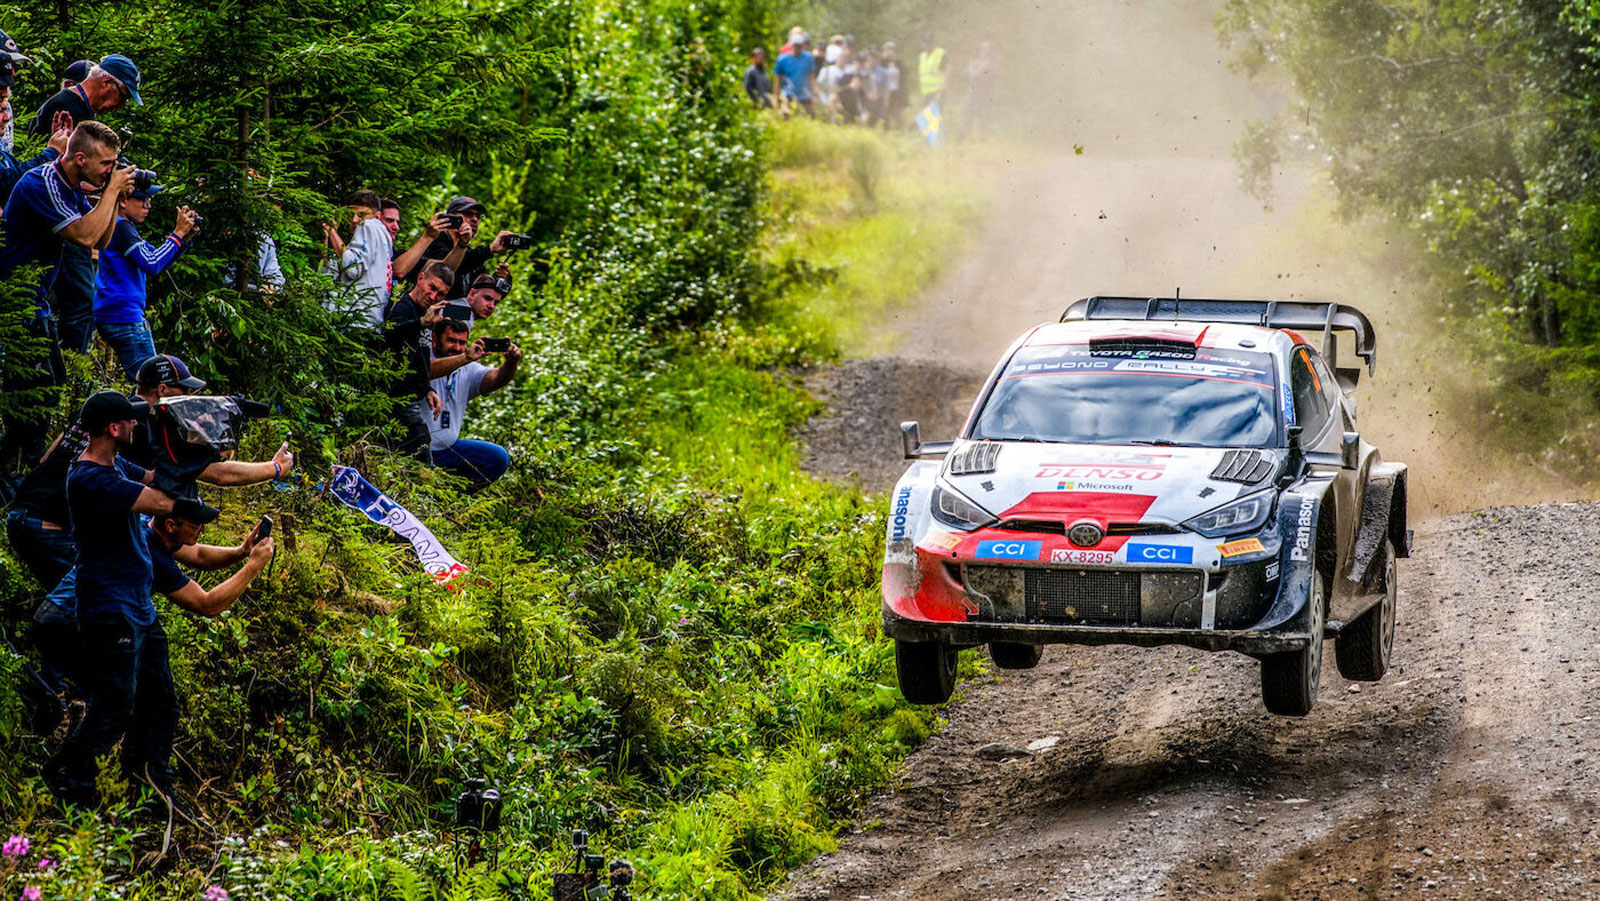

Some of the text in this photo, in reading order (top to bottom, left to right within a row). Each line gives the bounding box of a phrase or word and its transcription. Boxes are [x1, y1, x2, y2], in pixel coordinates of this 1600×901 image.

[1133, 350, 1195, 359] GAZOO
[1197, 354, 1252, 366] Racing
[1011, 361, 1205, 372] BEYOND RALLY
[1035, 468, 1164, 481] DENSO
[1077, 482, 1133, 491] Microsoft
[892, 486, 913, 553] anasoni
[1290, 494, 1315, 561] Panason
[992, 543, 1026, 555] CCI
[1142, 547, 1177, 559] CCI
[1052, 551, 1114, 564] KX-8295
